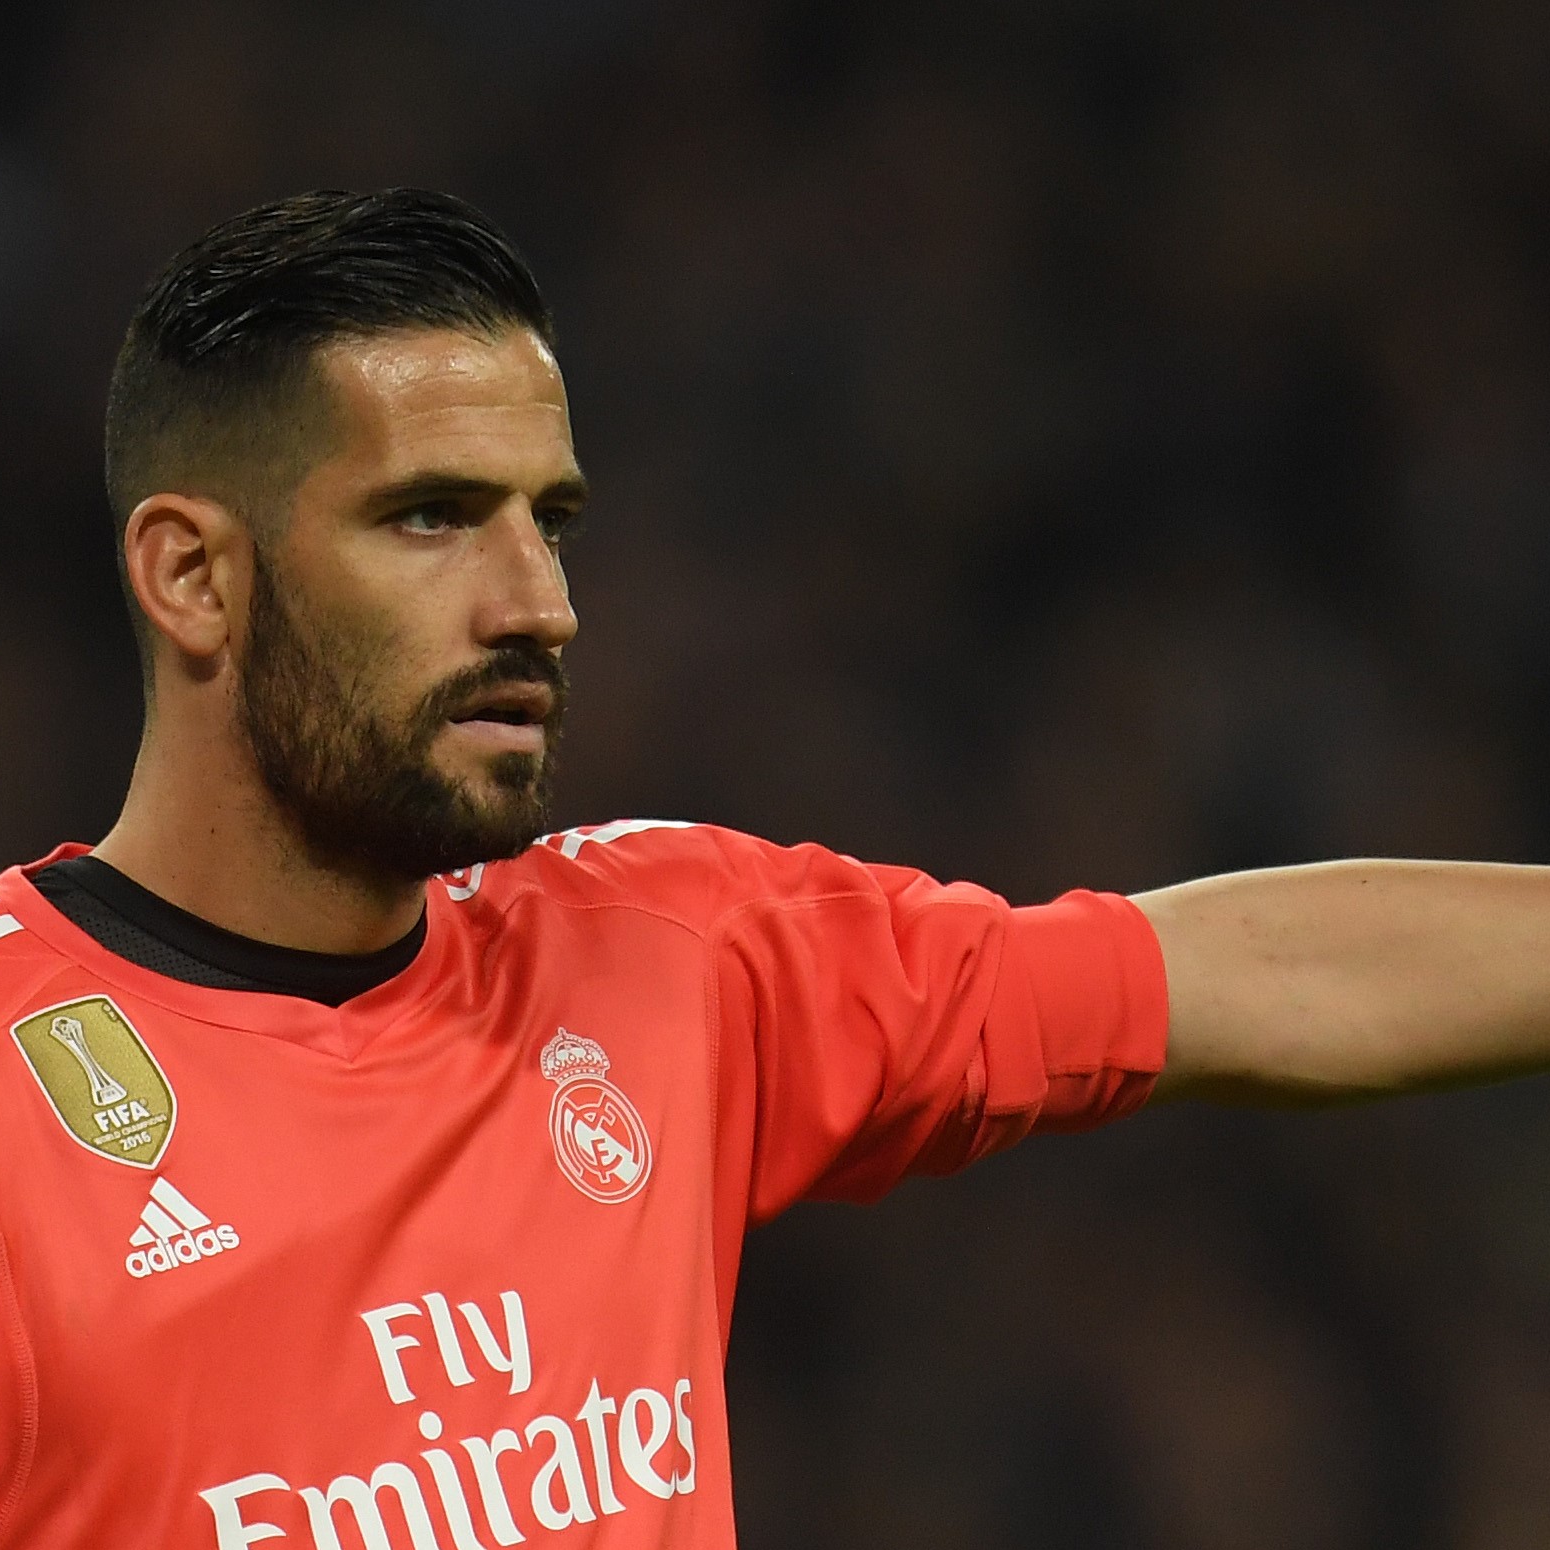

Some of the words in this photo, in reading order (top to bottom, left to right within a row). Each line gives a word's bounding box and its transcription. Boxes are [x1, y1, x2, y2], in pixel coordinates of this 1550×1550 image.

[93, 1100, 151, 1133] FIFA
[119, 1131, 152, 1151] 2016
[125, 1223, 241, 1279] adidas
[360, 1290, 533, 1404] Fly
